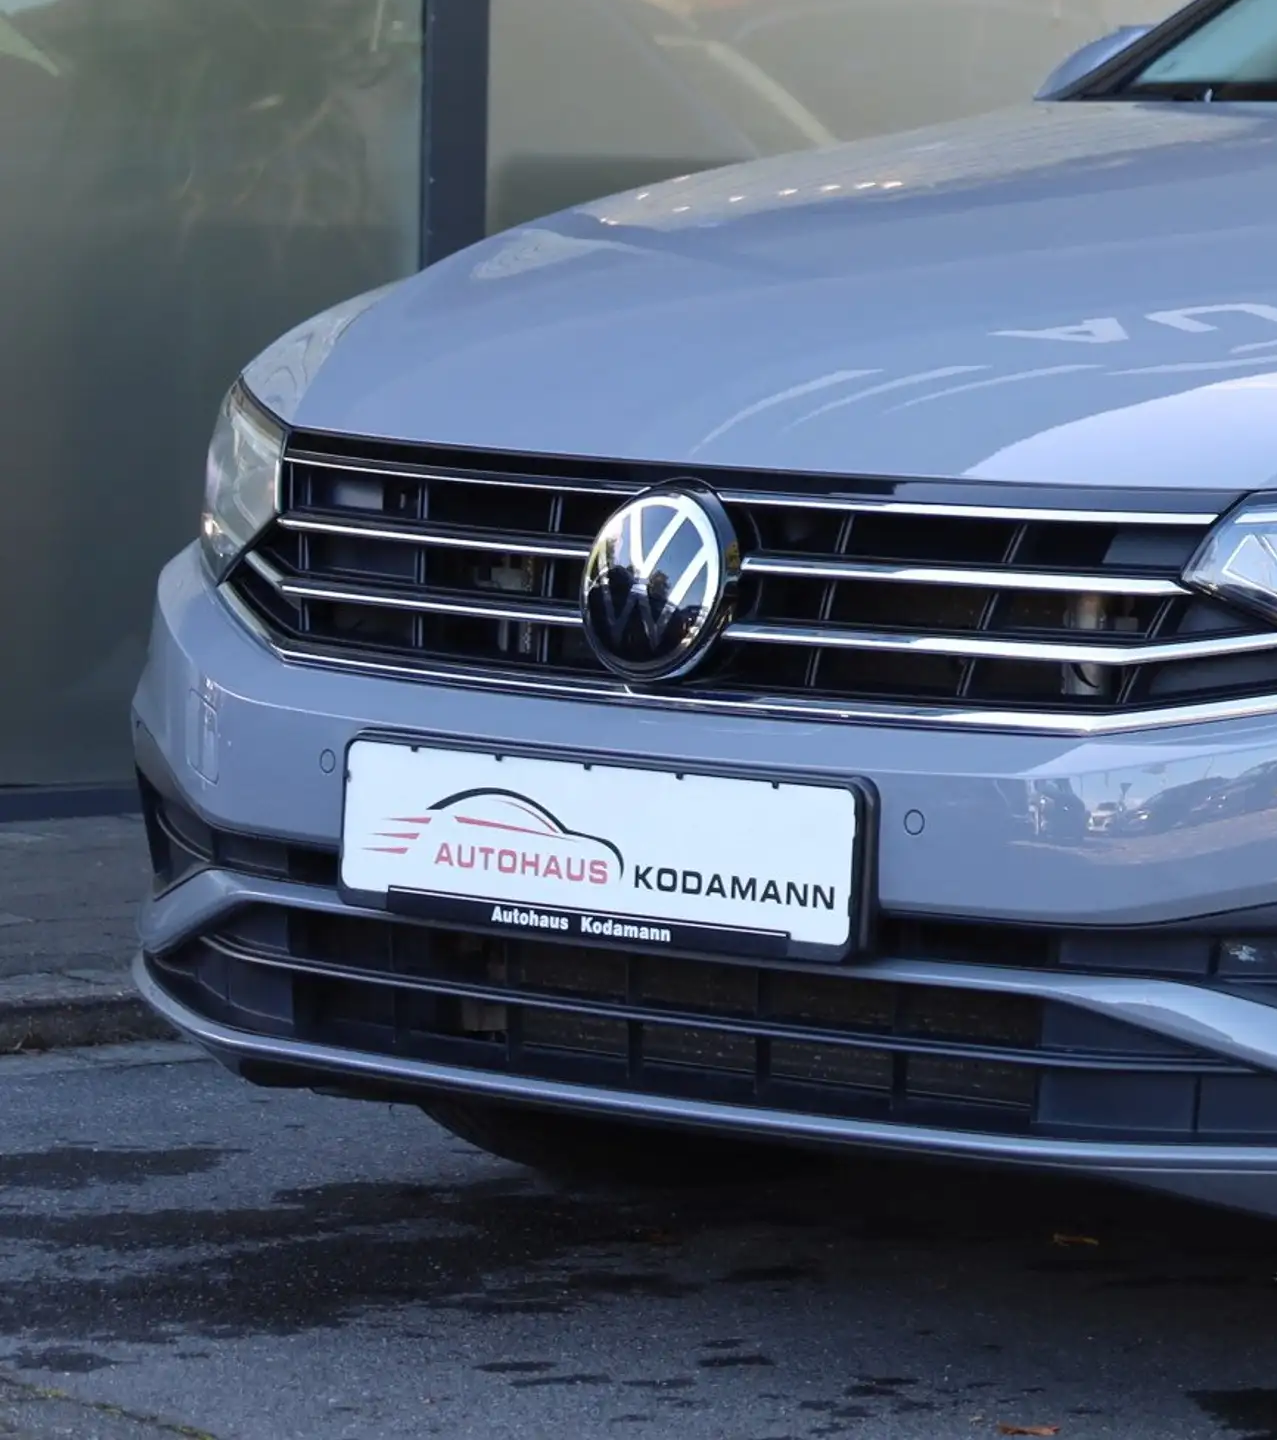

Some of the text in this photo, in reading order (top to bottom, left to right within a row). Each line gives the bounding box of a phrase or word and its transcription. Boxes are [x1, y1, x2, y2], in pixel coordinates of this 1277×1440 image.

[434, 843, 836, 910] AUTOHAUS KODAMANN
[491, 906, 672, 942] Autohaus Kodamann
